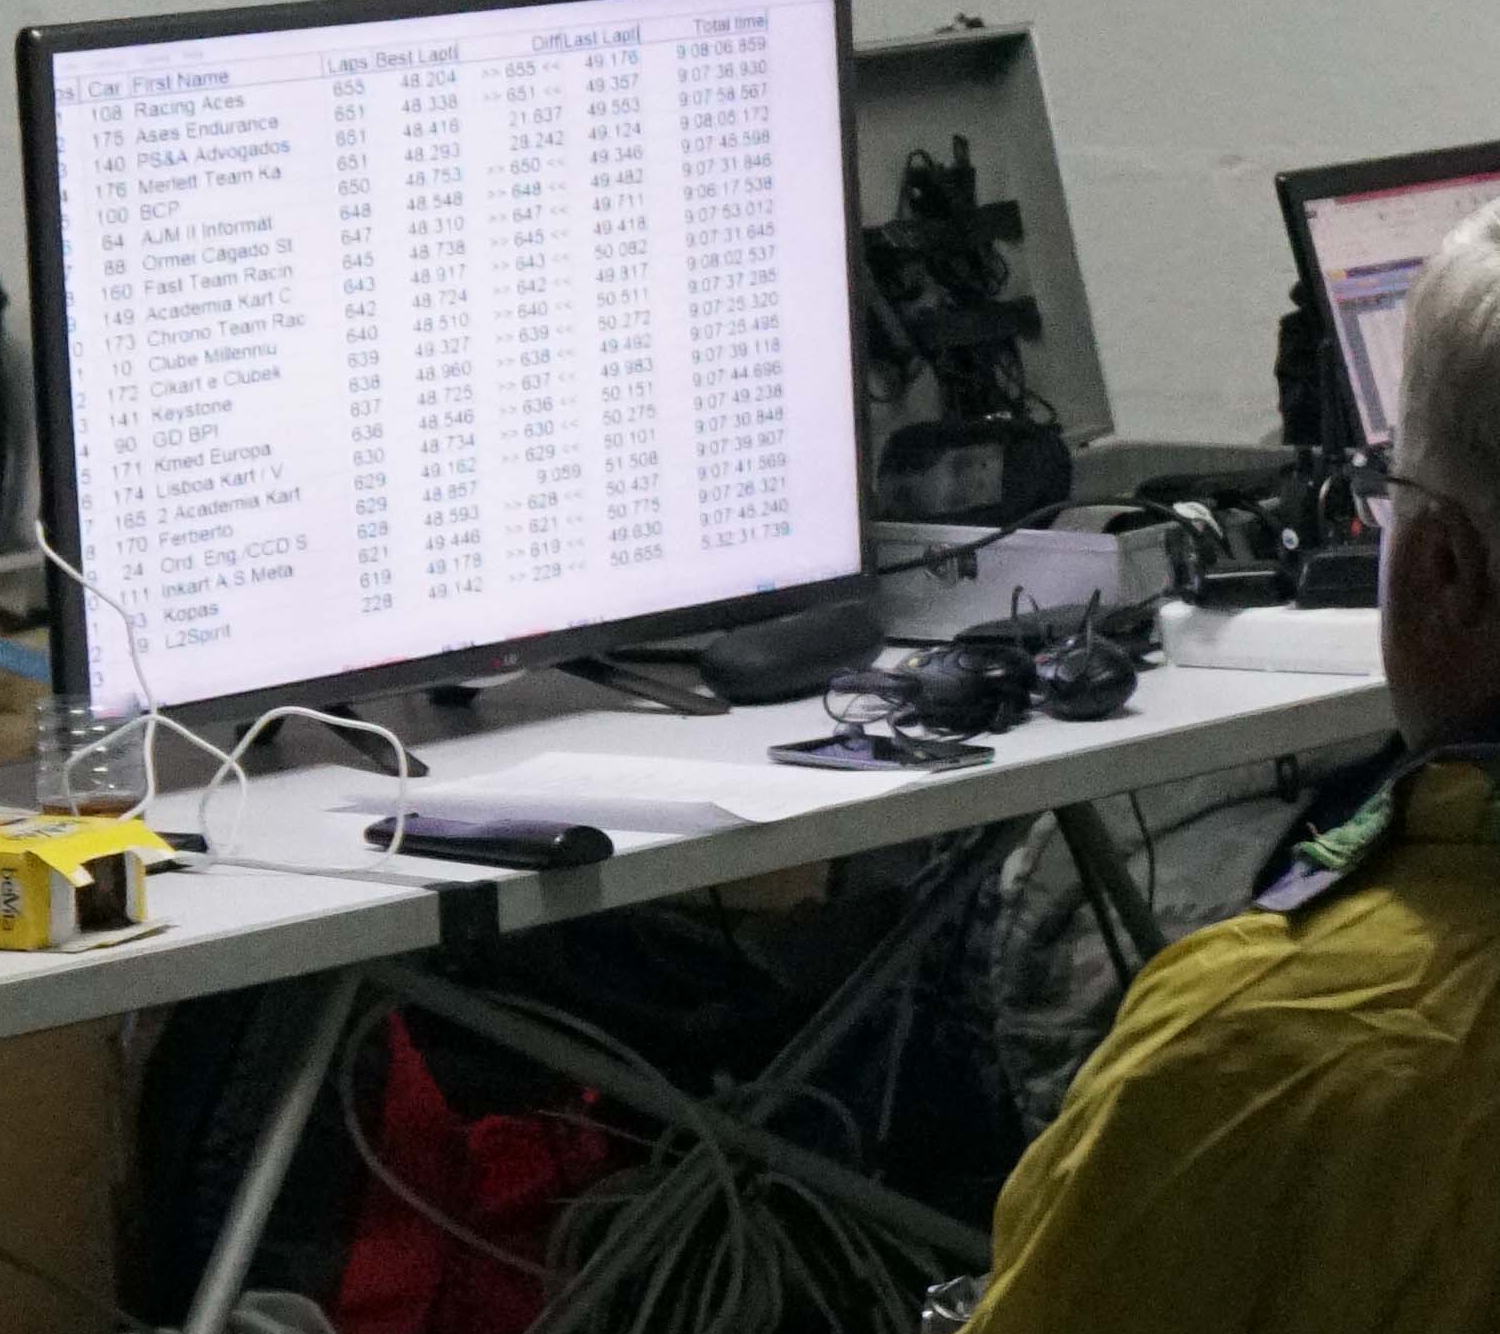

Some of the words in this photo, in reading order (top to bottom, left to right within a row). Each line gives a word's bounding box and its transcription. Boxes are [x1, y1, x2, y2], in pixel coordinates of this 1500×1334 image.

[88, 78, 120, 98] Car
[131, 73, 170, 94] First
[176, 67, 229, 89] Name
[327, 53, 368, 77] Laps
[375, 48, 412, 68] Best
[563, 29, 596, 48] Last
[693, 15, 729, 34] Total
[91, 103, 122, 123] 108
[134, 96, 195, 123] Racing
[201, 90, 244, 111] Aces
[332, 78, 364, 97] 655
[504, 59, 535, 79] 655
[93, 129, 124, 149] 175
[135, 123, 179, 144] Ases
[186, 112, 278, 139] Endurance
[333, 103, 364, 122] 651
[506, 84, 534, 103] 651
[94, 155, 125, 175] 140
[136, 148, 188, 170] PS&A
[195, 136, 290, 167] Advogados
[335, 127, 365, 147] 651
[96, 180, 126, 200] 176
[206, 165, 252, 187] Team
[258, 162, 281, 181] Ka
[336, 152, 367, 172] 651
[97, 206, 128, 226] 100
[139, 199, 180, 221] BCP
[338, 176, 370, 196] 650
[509, 156, 540, 175] 650
[101, 232, 123, 251] 64
[141, 225, 179, 246] AJM
[202, 213, 272, 238] Informat
[339, 201, 371, 221] 648
[511, 180, 541, 199] 648
[103, 257, 126, 277] 88
[340, 226, 372, 246] 647
[512, 204, 543, 224] 647
[101, 282, 132, 302] 160
[144, 276, 182, 297] Fast
[190, 268, 237, 291] Team
[244, 261, 292, 283] Racin
[342, 250, 374, 270] 645
[513, 228, 544, 248] 645
[103, 307, 134, 328] 149
[145, 294, 232, 322] Academia
[238, 289, 272, 309] Kart
[343, 275, 375, 295] 643
[515, 252, 545, 272] 643
[112, 359, 132, 378] 10
[148, 350, 198, 373] Clube
[346, 324, 378, 344] 640
[517, 300, 548, 320] 640
[147, 322, 211, 347] Chrono
[219, 315, 266, 337] Team
[272, 309, 305, 330] Rac
[344, 299, 377, 320] 642
[516, 276, 546, 296] 642
[347, 348, 379, 369] 639
[518, 324, 549, 344] 639
[109, 409, 138, 429] 141
[151, 395, 233, 427] Keystone
[349, 373, 381, 393] 638
[520, 348, 550, 368] 638
[114, 435, 136, 454] 90
[152, 428, 182, 448] GD
[350, 397, 382, 418] 637
[521, 371, 551, 391] 637
[112, 460, 141, 480] 171
[210, 439, 271, 469] Europa
[351, 422, 383, 442] 636
[522, 395, 553, 415] 636
[114, 485, 143, 505] 174
[156, 474, 214, 499] Lisboa
[221, 467, 255, 488] Kart
[353, 446, 385, 467] 630
[523, 419, 554, 439] 630
[116, 510, 146, 531] 165
[174, 491, 259, 521] Academia
[266, 485, 300, 506] Kart
[354, 470, 386, 491] 629
[525, 443, 555, 463] 629
[117, 535, 147, 556] 170
[356, 495, 387, 516] 629
[120, 585, 148, 606] 111
[161, 575, 209, 599] Inkart
[358, 544, 389, 564] 621
[528, 514, 557, 535] 621
[122, 561, 143, 580] 24
[357, 519, 389, 540] 628
[527, 490, 558, 511] 628
[163, 599, 218, 628] Kopas
[360, 568, 392, 589] 619
[530, 538, 560, 558] 619
[361, 592, 393, 613] 228
